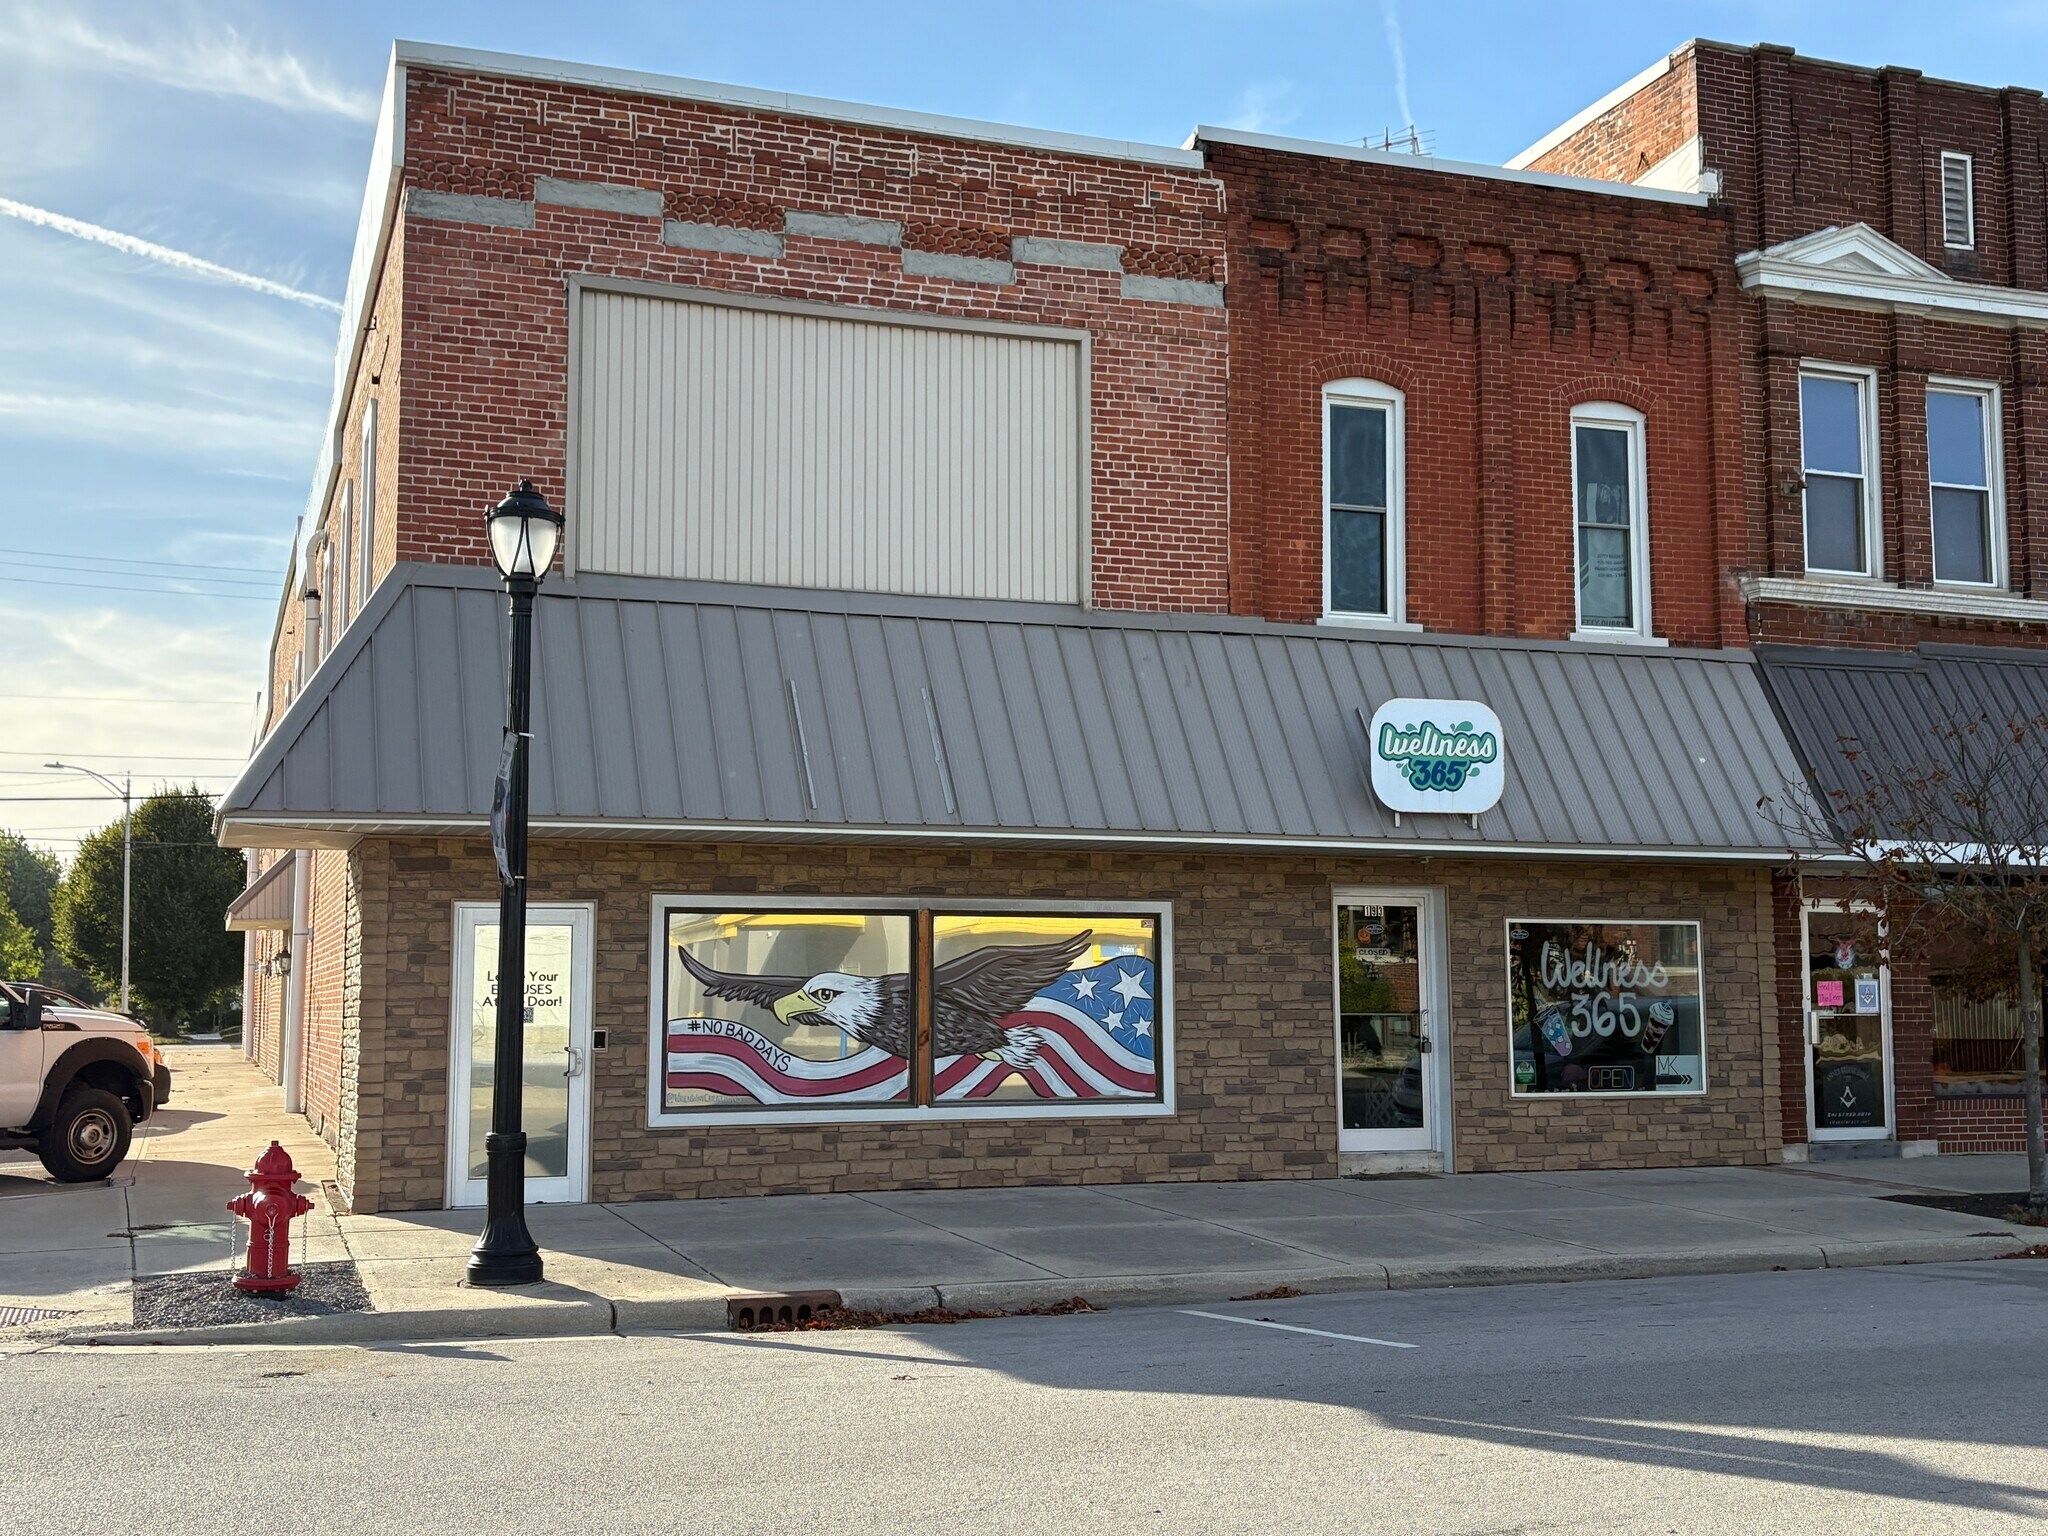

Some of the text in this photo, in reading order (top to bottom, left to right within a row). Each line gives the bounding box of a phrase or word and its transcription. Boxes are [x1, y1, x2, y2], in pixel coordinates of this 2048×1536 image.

[1381, 723, 1495, 761] Wellness
[1412, 759, 1468, 787] 365
[1365, 906, 1383, 916] 193
[1541, 941, 1669, 988] Wellness
[529, 970, 558, 981] Your
[491, 984, 553, 995] EUSES
[528, 996, 562, 1007] Door!
[1571, 991, 1641, 1037] 365
[687, 1019, 791, 1072] #NO BAD DAYS
[1657, 1055, 1679, 1076] MK
[1590, 1068, 1632, 1088] OPEN
